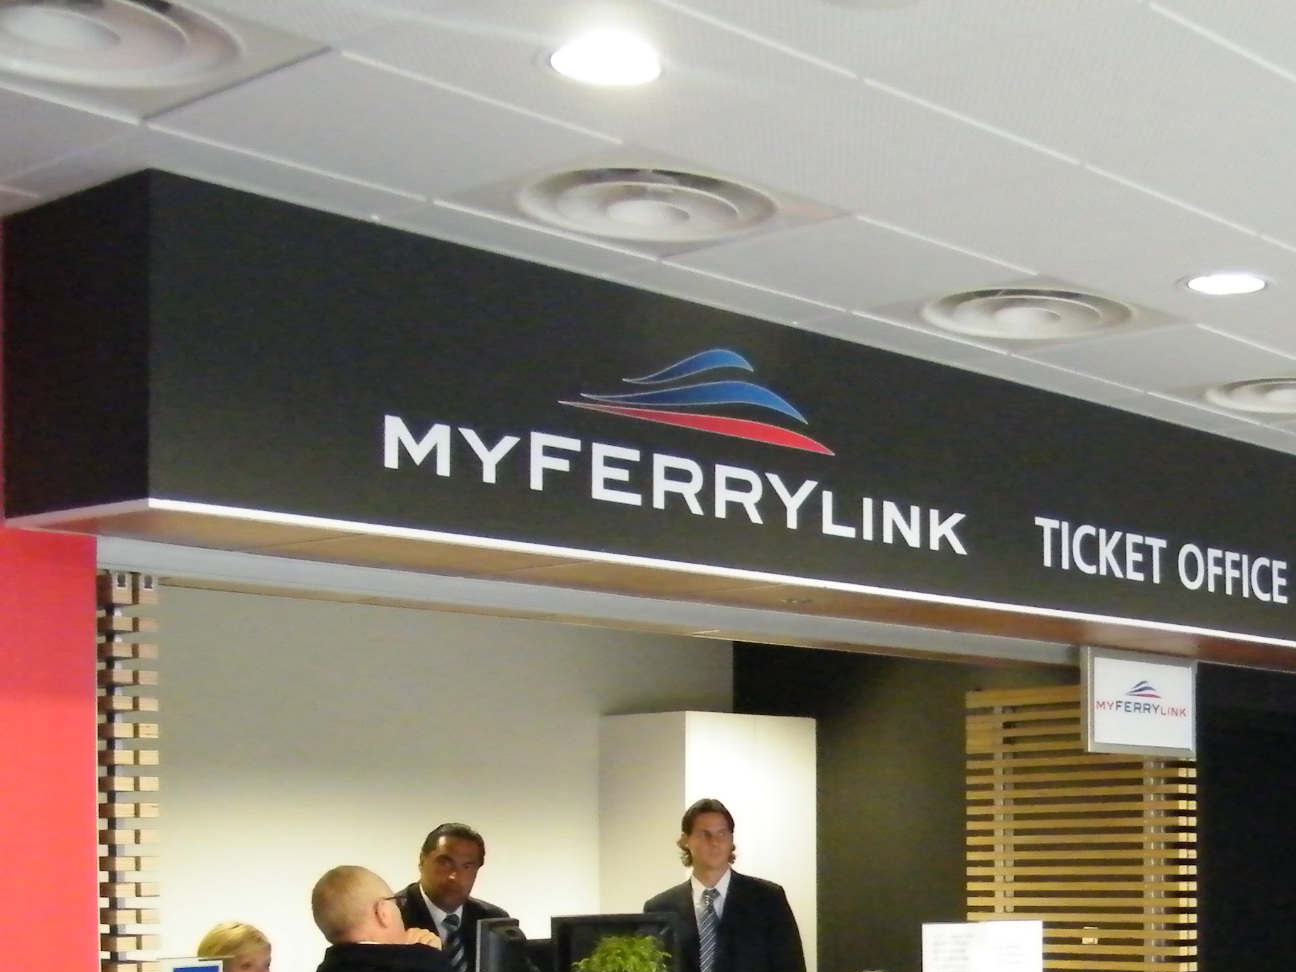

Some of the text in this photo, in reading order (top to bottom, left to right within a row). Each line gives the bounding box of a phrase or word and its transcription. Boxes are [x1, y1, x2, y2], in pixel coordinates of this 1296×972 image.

[383, 414, 968, 557] MYFERRYLINK
[1035, 516, 1289, 605] TICKET OFFICE
[1096, 700, 1187, 717] MYFERRYLINK
